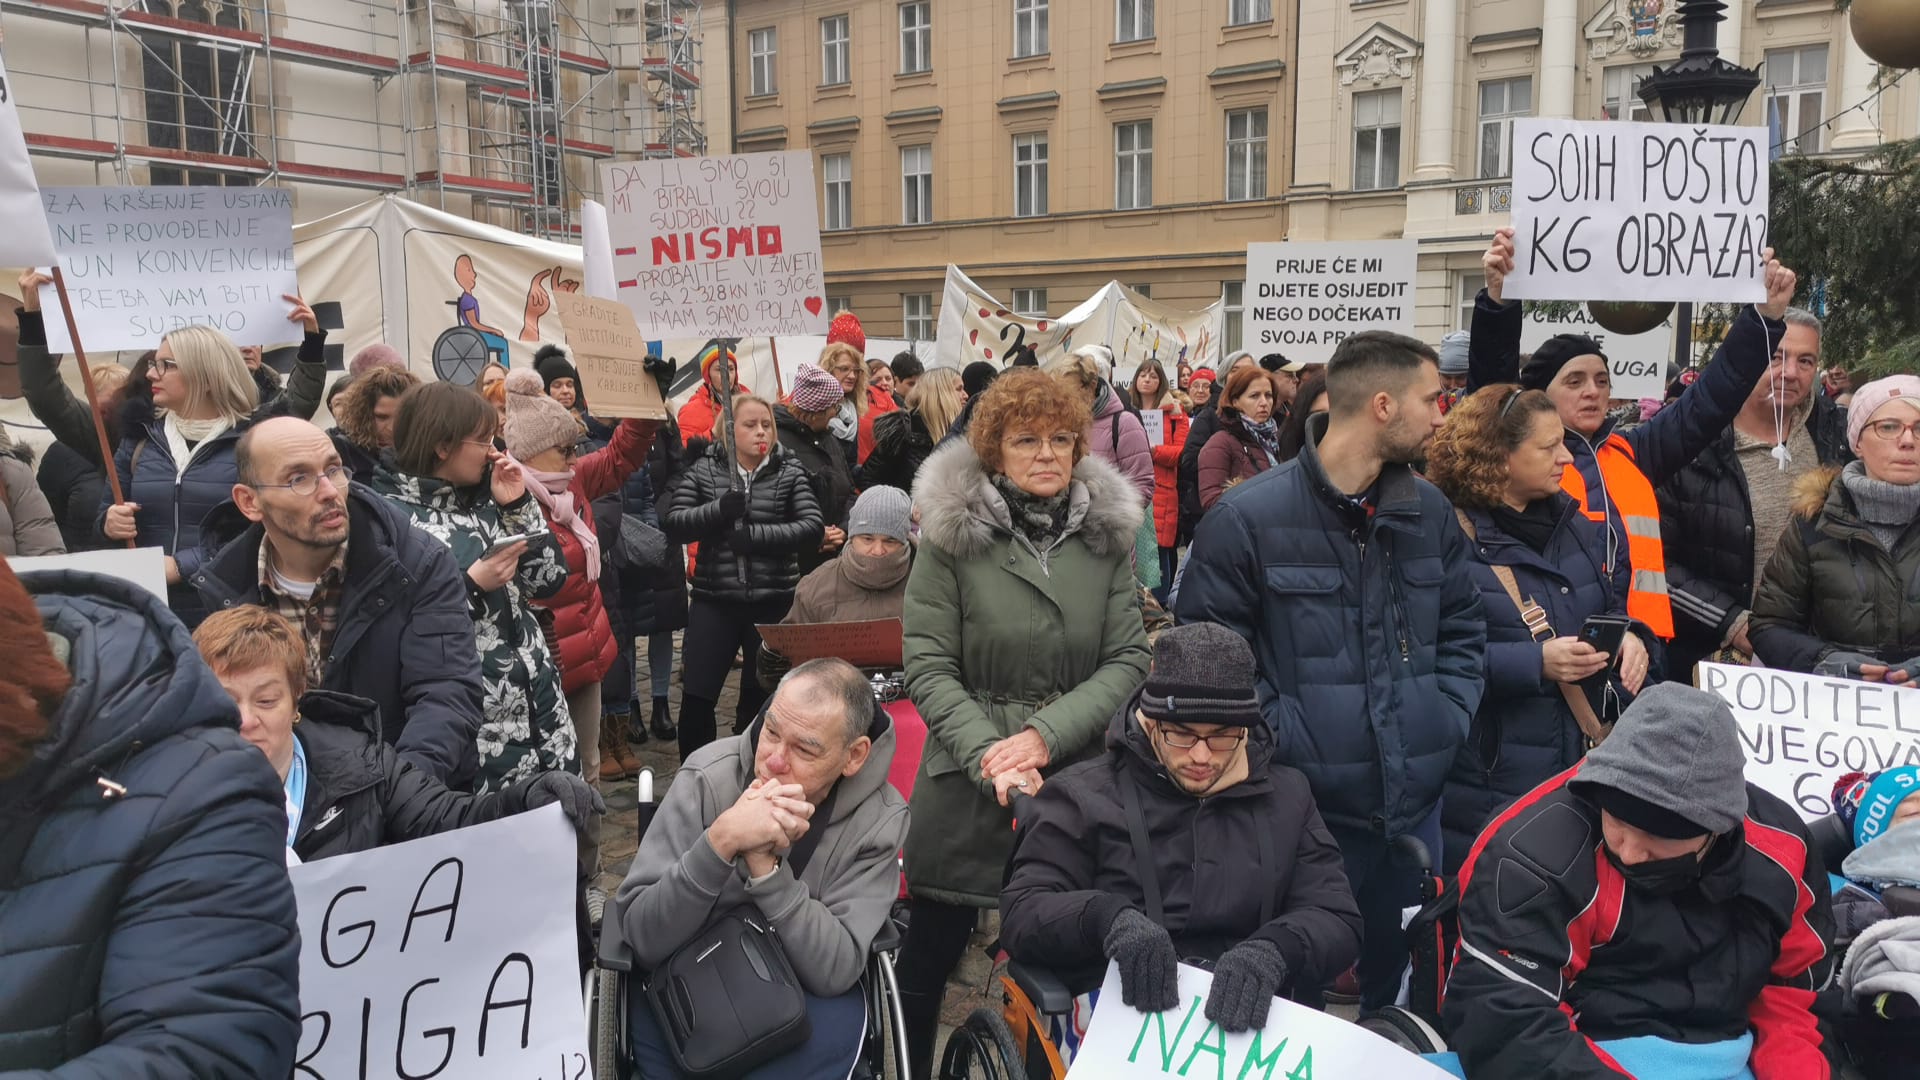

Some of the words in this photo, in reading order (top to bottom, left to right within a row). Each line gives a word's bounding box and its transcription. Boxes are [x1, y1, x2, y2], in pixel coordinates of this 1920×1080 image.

[611, 166, 646, 192] DA
[661, 162, 683, 188] LI
[700, 158, 750, 184] SMO
[769, 155, 787, 178] SI
[1527, 131, 1616, 202] SOIH
[1642, 128, 1758, 206] POŠTO
[48, 192, 85, 215] ZA
[104, 188, 206, 213] KRŠENJE
[223, 190, 294, 209] USTAVA
[613, 194, 632, 214] MI
[654, 184, 715, 210] BIRALI
[736, 178, 791, 206] SVOJU
[650, 206, 730, 231] SUDBINU
[735, 200, 756, 220] ??
[57, 222, 95, 247] NE
[106, 217, 261, 244] PROVOĐENJE
[651, 224, 783, 266] NISMO
[1529, 215, 1592, 276] KG
[1616, 211, 1768, 280] OBRAZA?
[69, 251, 113, 279] UN
[137, 247, 295, 275] KONVENCIJE
[637, 258, 730, 292] PROBAJTE
[743, 257, 764, 277] VI
[1276, 258, 1326, 275] PRIJE
[1332, 256, 1357, 274] ĆE
[1362, 258, 1383, 273] MI
[52, 287, 150, 310] REBA
[158, 287, 207, 306] VAM
[218, 283, 272, 304] BITI
[649, 290, 675, 307] SA
[1259, 283, 1319, 298] DIJETE
[1325, 281, 1409, 299] OSIJEDIT
[649, 307, 698, 333] IMAM
[706, 302, 749, 327] SAMO
[755, 298, 803, 322] POLA
[1252, 306, 1304, 322] NEGO
[1308, 304, 1401, 322] DOČEKATI
[1260, 330, 1318, 345] SVOJA
[1323, 330, 1357, 345] PR
[1860, 793, 1896, 845] COOL
[320, 856, 464, 969] GA
